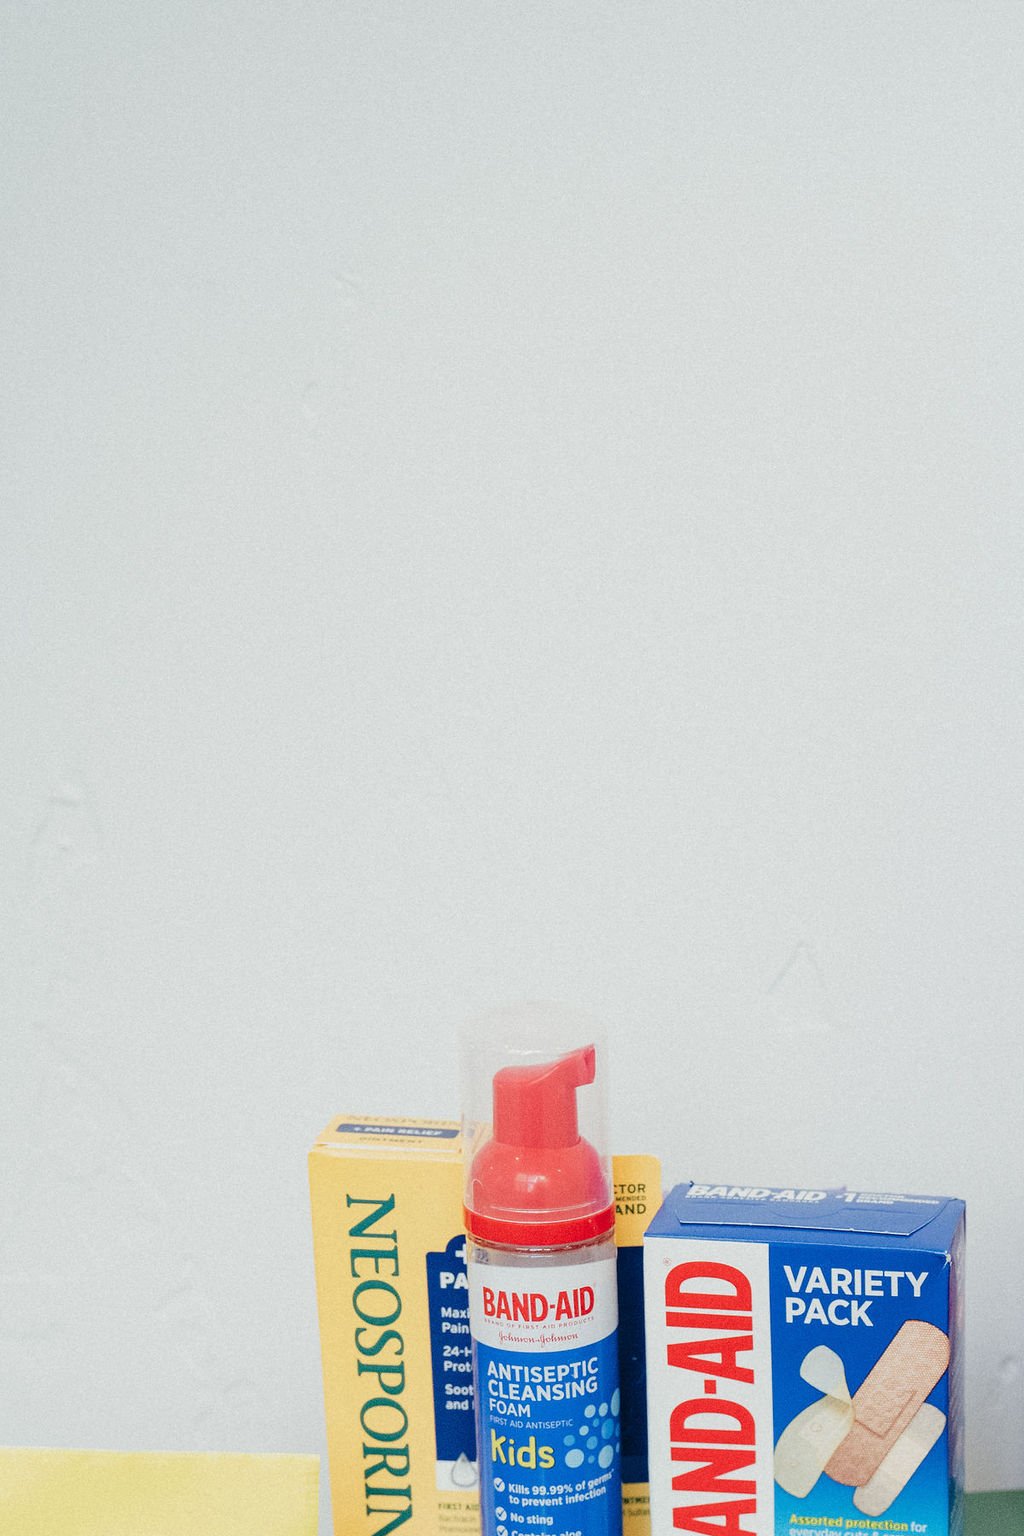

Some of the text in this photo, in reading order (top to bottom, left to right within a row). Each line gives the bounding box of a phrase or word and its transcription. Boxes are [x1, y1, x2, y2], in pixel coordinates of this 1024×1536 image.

[783, 1265, 928, 1297] VARIETY
[483, 1286, 594, 1323] BAND-AID
[785, 1297, 873, 1327] PACK
[488, 1357, 598, 1383] ANTISEPTIC
[488, 1377, 598, 1401] CLEANSING
[489, 1398, 531, 1417] FOAM
[491, 1429, 555, 1469] Kids
[509, 1484, 529, 1495] Kills
[532, 1484, 573, 1495] 99.99%
[576, 1480, 586, 1491] of
[509, 1486, 606, 1507] to prevent infection
[510, 1514, 553, 1526] No sting
[789, 1514, 927, 1532] Assorted protection for
